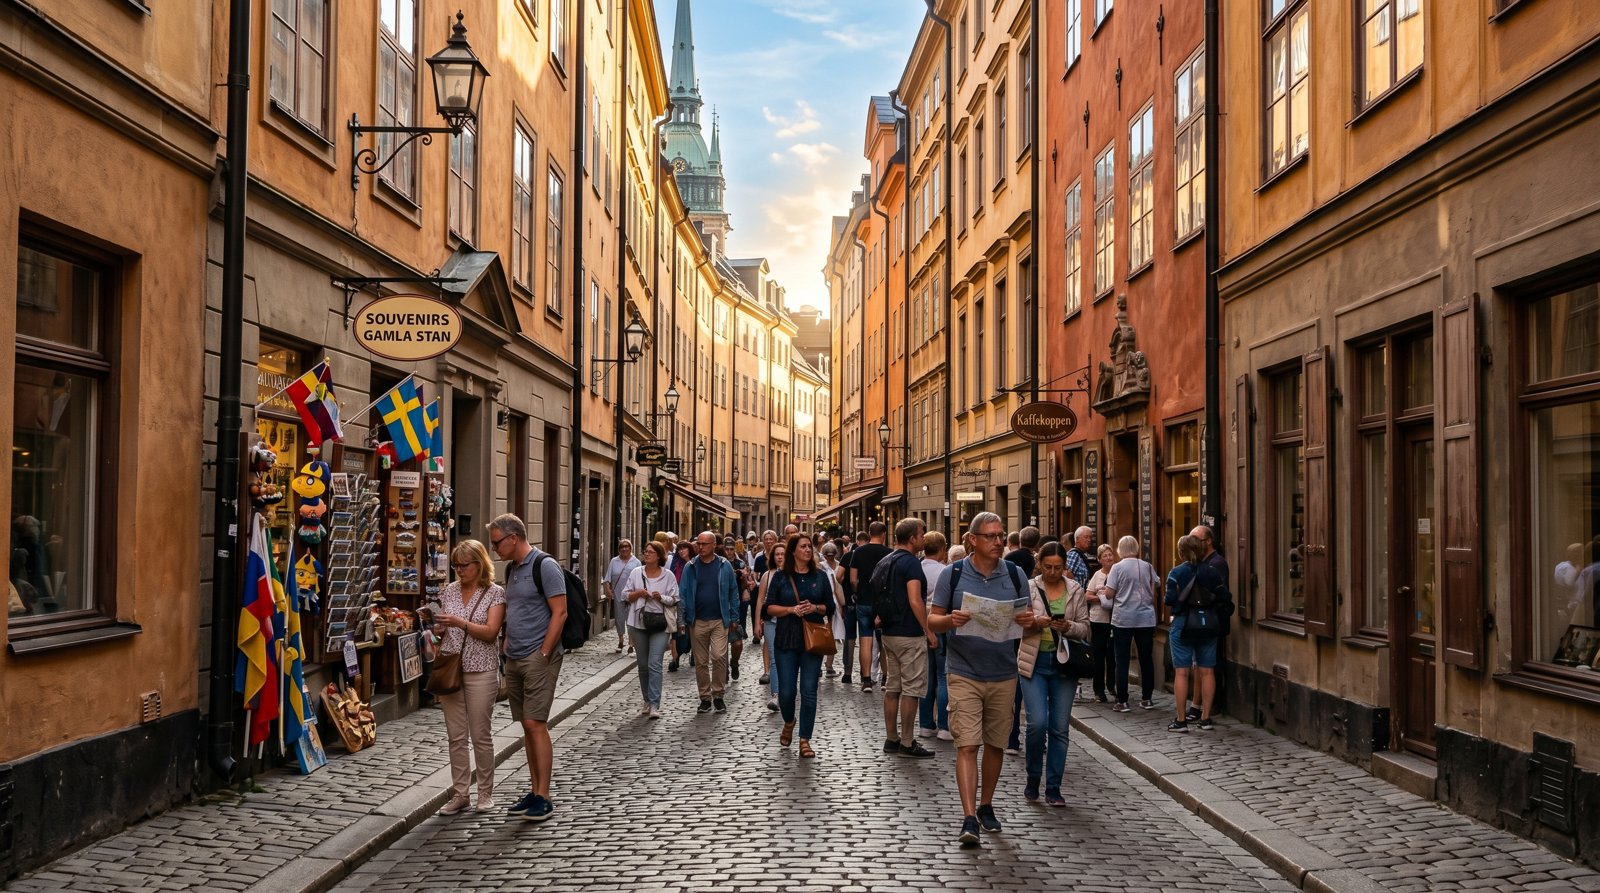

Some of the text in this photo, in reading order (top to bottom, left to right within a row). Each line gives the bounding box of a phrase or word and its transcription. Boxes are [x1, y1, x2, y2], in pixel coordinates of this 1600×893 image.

[366, 313, 449, 326] SOUVENIRS
[363, 330, 451, 342] GAMLA STAN
[1017, 413, 1071, 429] Kaffekoppen
